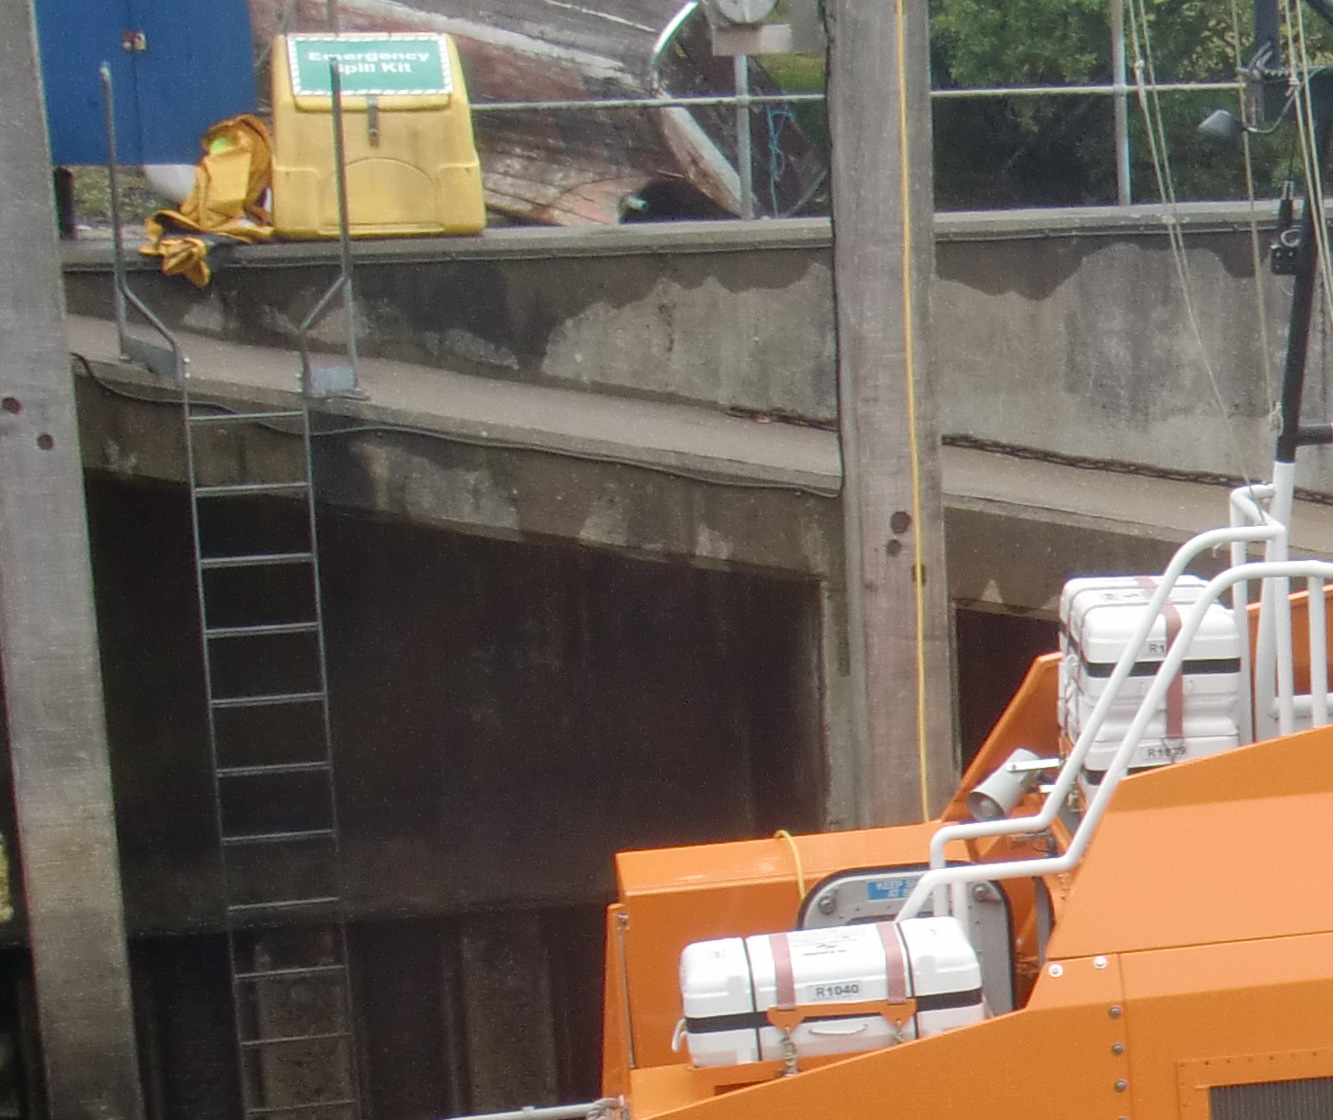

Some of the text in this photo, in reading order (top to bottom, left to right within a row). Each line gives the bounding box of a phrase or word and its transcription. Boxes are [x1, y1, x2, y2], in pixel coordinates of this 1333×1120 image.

[307, 51, 430, 62] Emergency
[338, 63, 412, 75] pill Kit
[815, 984, 860, 998] R1040
